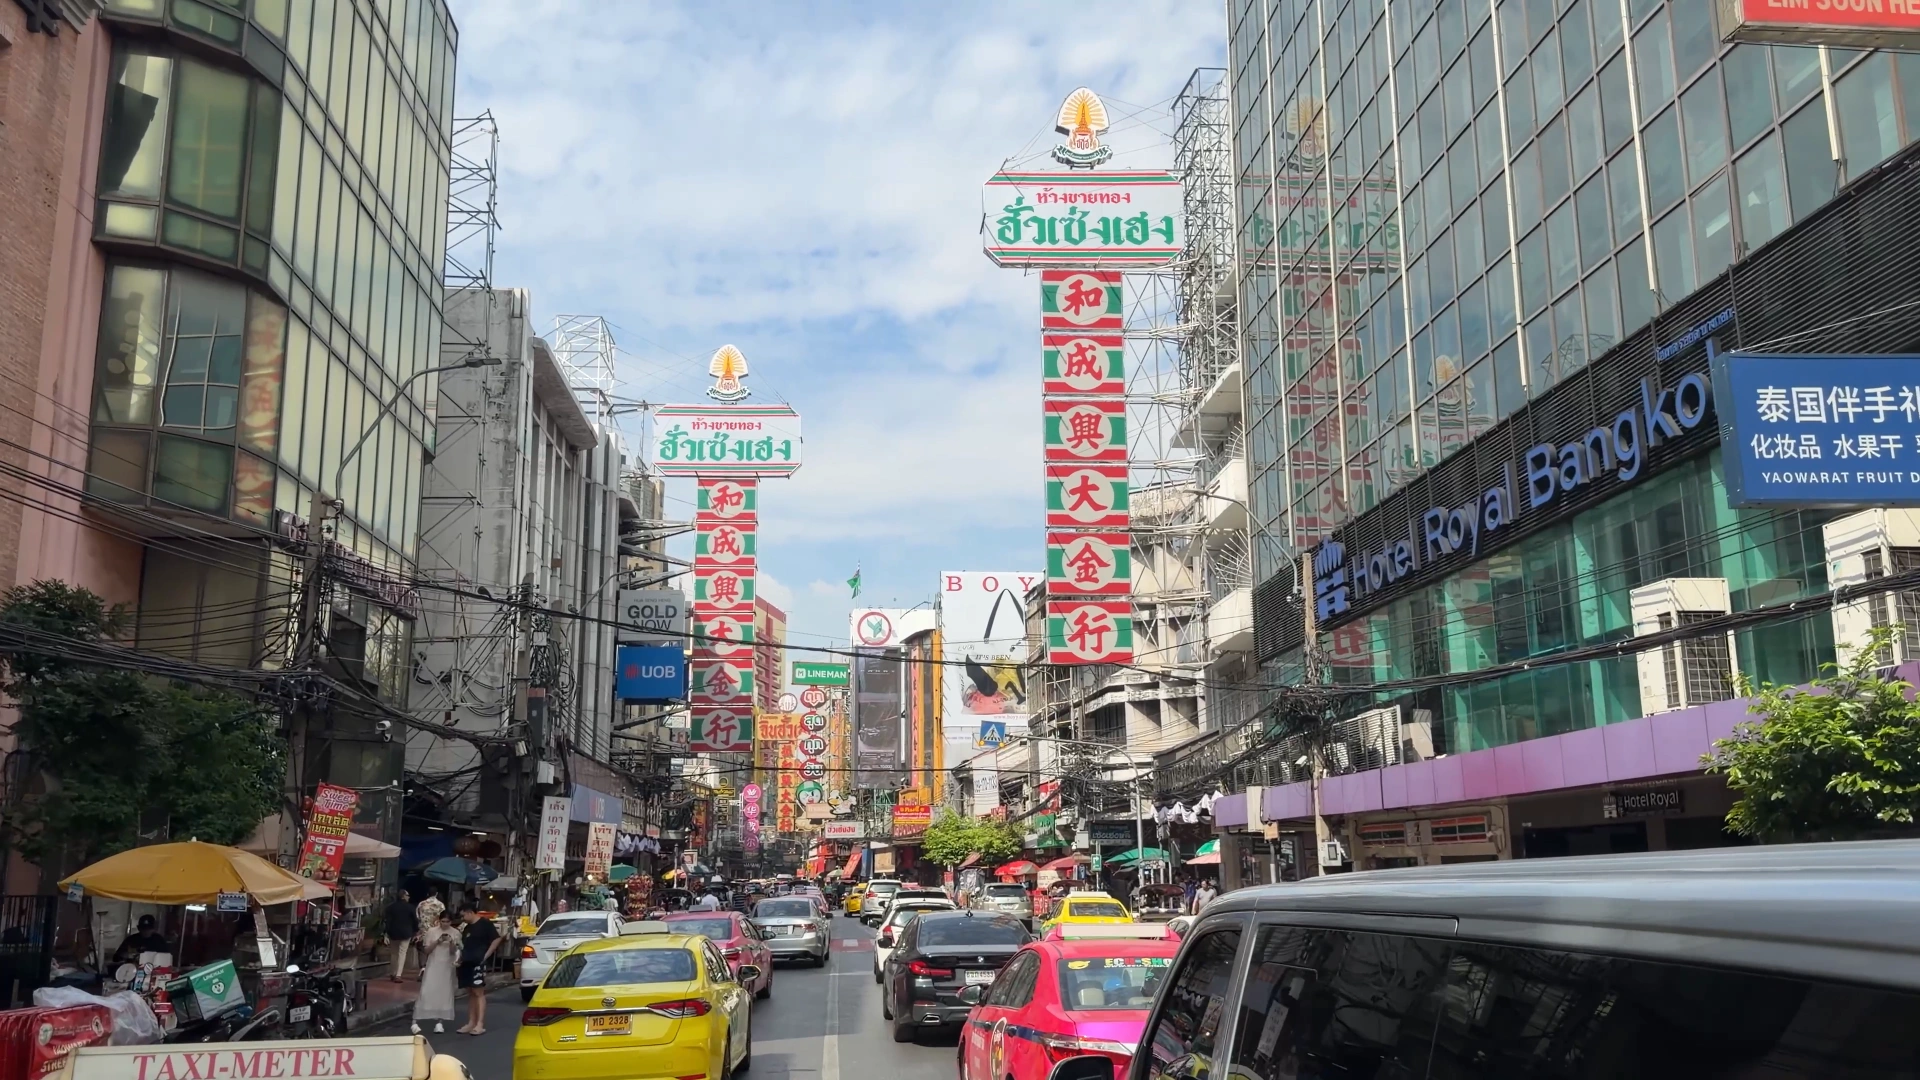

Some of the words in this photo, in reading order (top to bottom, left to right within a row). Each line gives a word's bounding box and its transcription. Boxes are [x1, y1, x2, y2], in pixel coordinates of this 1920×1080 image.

[1036, 187, 1132, 204] ห้างขายทอง
[996, 196, 1176, 246] ฮั่วเซ่งเฮง
[691, 417, 762, 431] ห้างขายทอง
[659, 424, 792, 462] ฮั่วเซ่งเฮง
[1750, 433, 1822, 460] 化妆品
[1833, 433, 1904, 460] 水果干
[1352, 519, 1421, 600] Hotel
[1424, 462, 1520, 560] Royal
[1526, 335, 1718, 510] Bangko
[1762, 472, 1850, 484] YAOWARAT
[1856, 472, 1904, 484] FRUIT
[627, 605, 677, 619] GOLD
[633, 620, 671, 631] NOW
[642, 665, 675, 679] UOB
[807, 669, 847, 679] LINEMAN
[322, 788, 355, 802] Sweet
[1649, 790, 1679, 807] Royal
[323, 798, 348, 811] Time
[313, 812, 349, 827] เกาลัด
[608, 1016, 629, 1025] 2328
[133, 1048, 355, 1080] TAXI-METER
